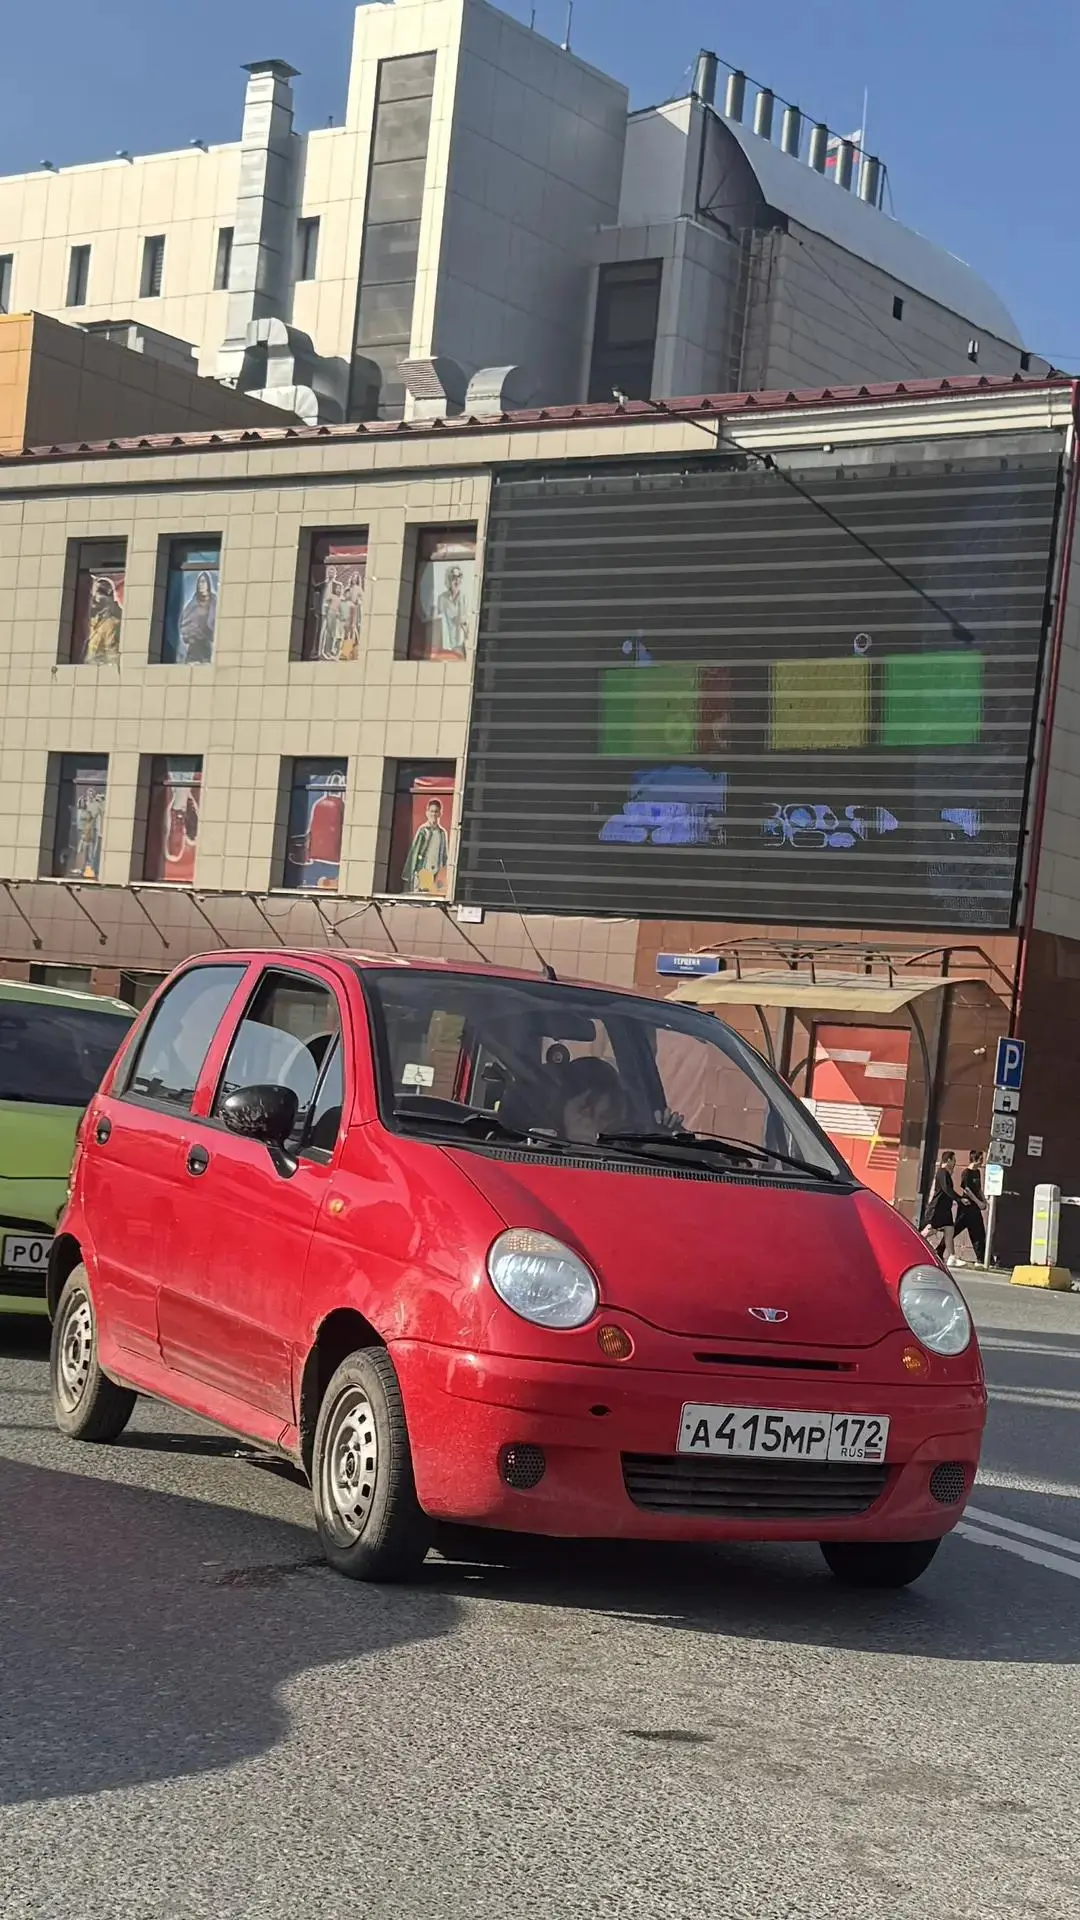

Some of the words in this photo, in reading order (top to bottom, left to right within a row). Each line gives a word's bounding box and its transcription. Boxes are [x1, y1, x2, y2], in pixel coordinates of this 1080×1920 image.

[1003, 1044, 1020, 1083] P
[13, 1242, 52, 1263] Р0
[834, 1418, 881, 1448] 172
[841, 1448, 864, 1458] RUS
